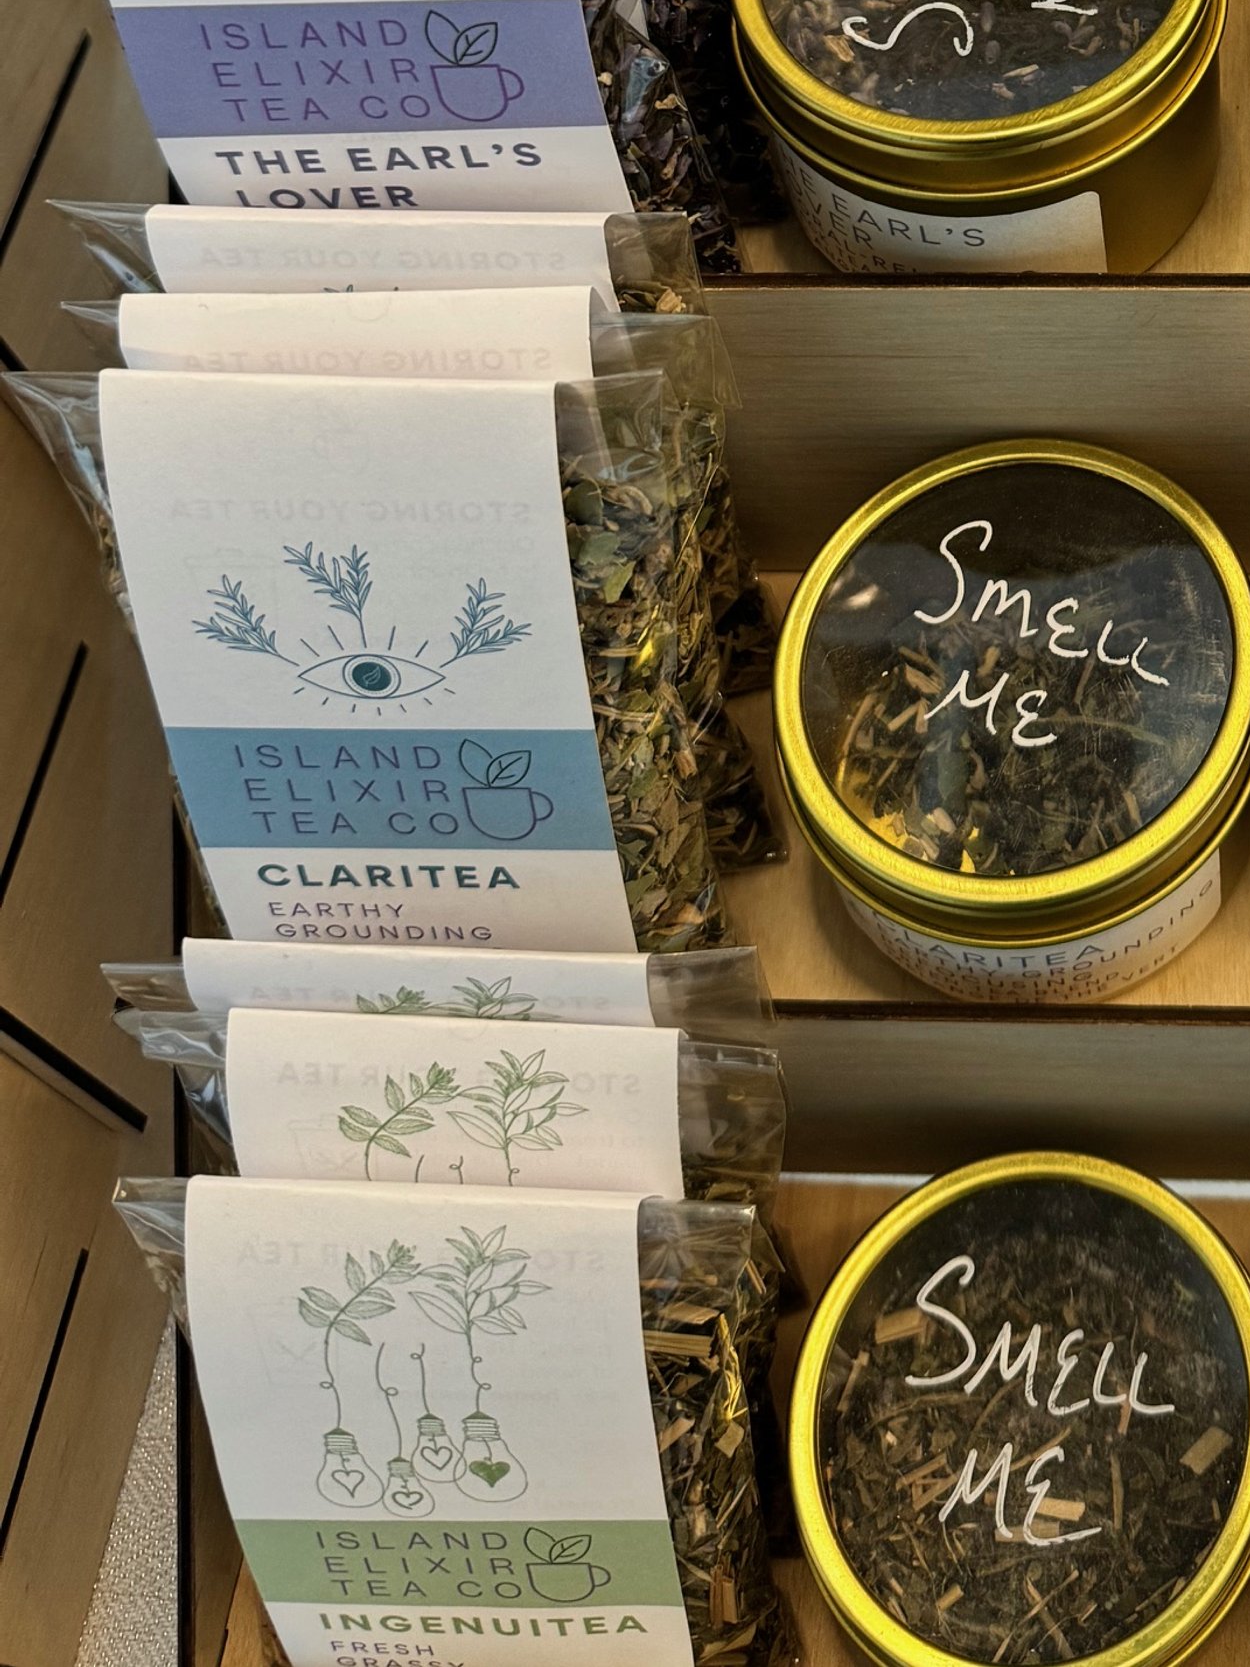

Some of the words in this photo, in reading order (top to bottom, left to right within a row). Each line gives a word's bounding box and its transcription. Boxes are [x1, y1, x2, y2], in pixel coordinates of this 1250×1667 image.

[201, 18, 409, 52] ISLAND
[212, 57, 420, 89] ELIXIR
[222, 97, 328, 124] TEA
[359, 93, 431, 121] CO
[215, 148, 327, 175] THE
[235, 185, 419, 210] LOVER
[924, 670, 1057, 747] ME
[235, 744, 443, 770] ISLAND
[244, 778, 451, 803] ELIXIR
[252, 811, 357, 835] TEA
[388, 810, 460, 835] CO
[258, 863, 521, 891] CLARITEA
[267, 901, 405, 918] EARTHY
[275, 922, 494, 941] GROUNDING
[939, 1443, 1101, 1546] ME
[316, 1531, 507, 1551] ISLAND
[324, 1555, 514, 1576] ELIXIR
[331, 1579, 418, 1599] TEA
[458, 1580, 522, 1600] CO
[319, 1613, 649, 1637] INGENUITEA
[330, 1640, 435, 1657] FRESH
